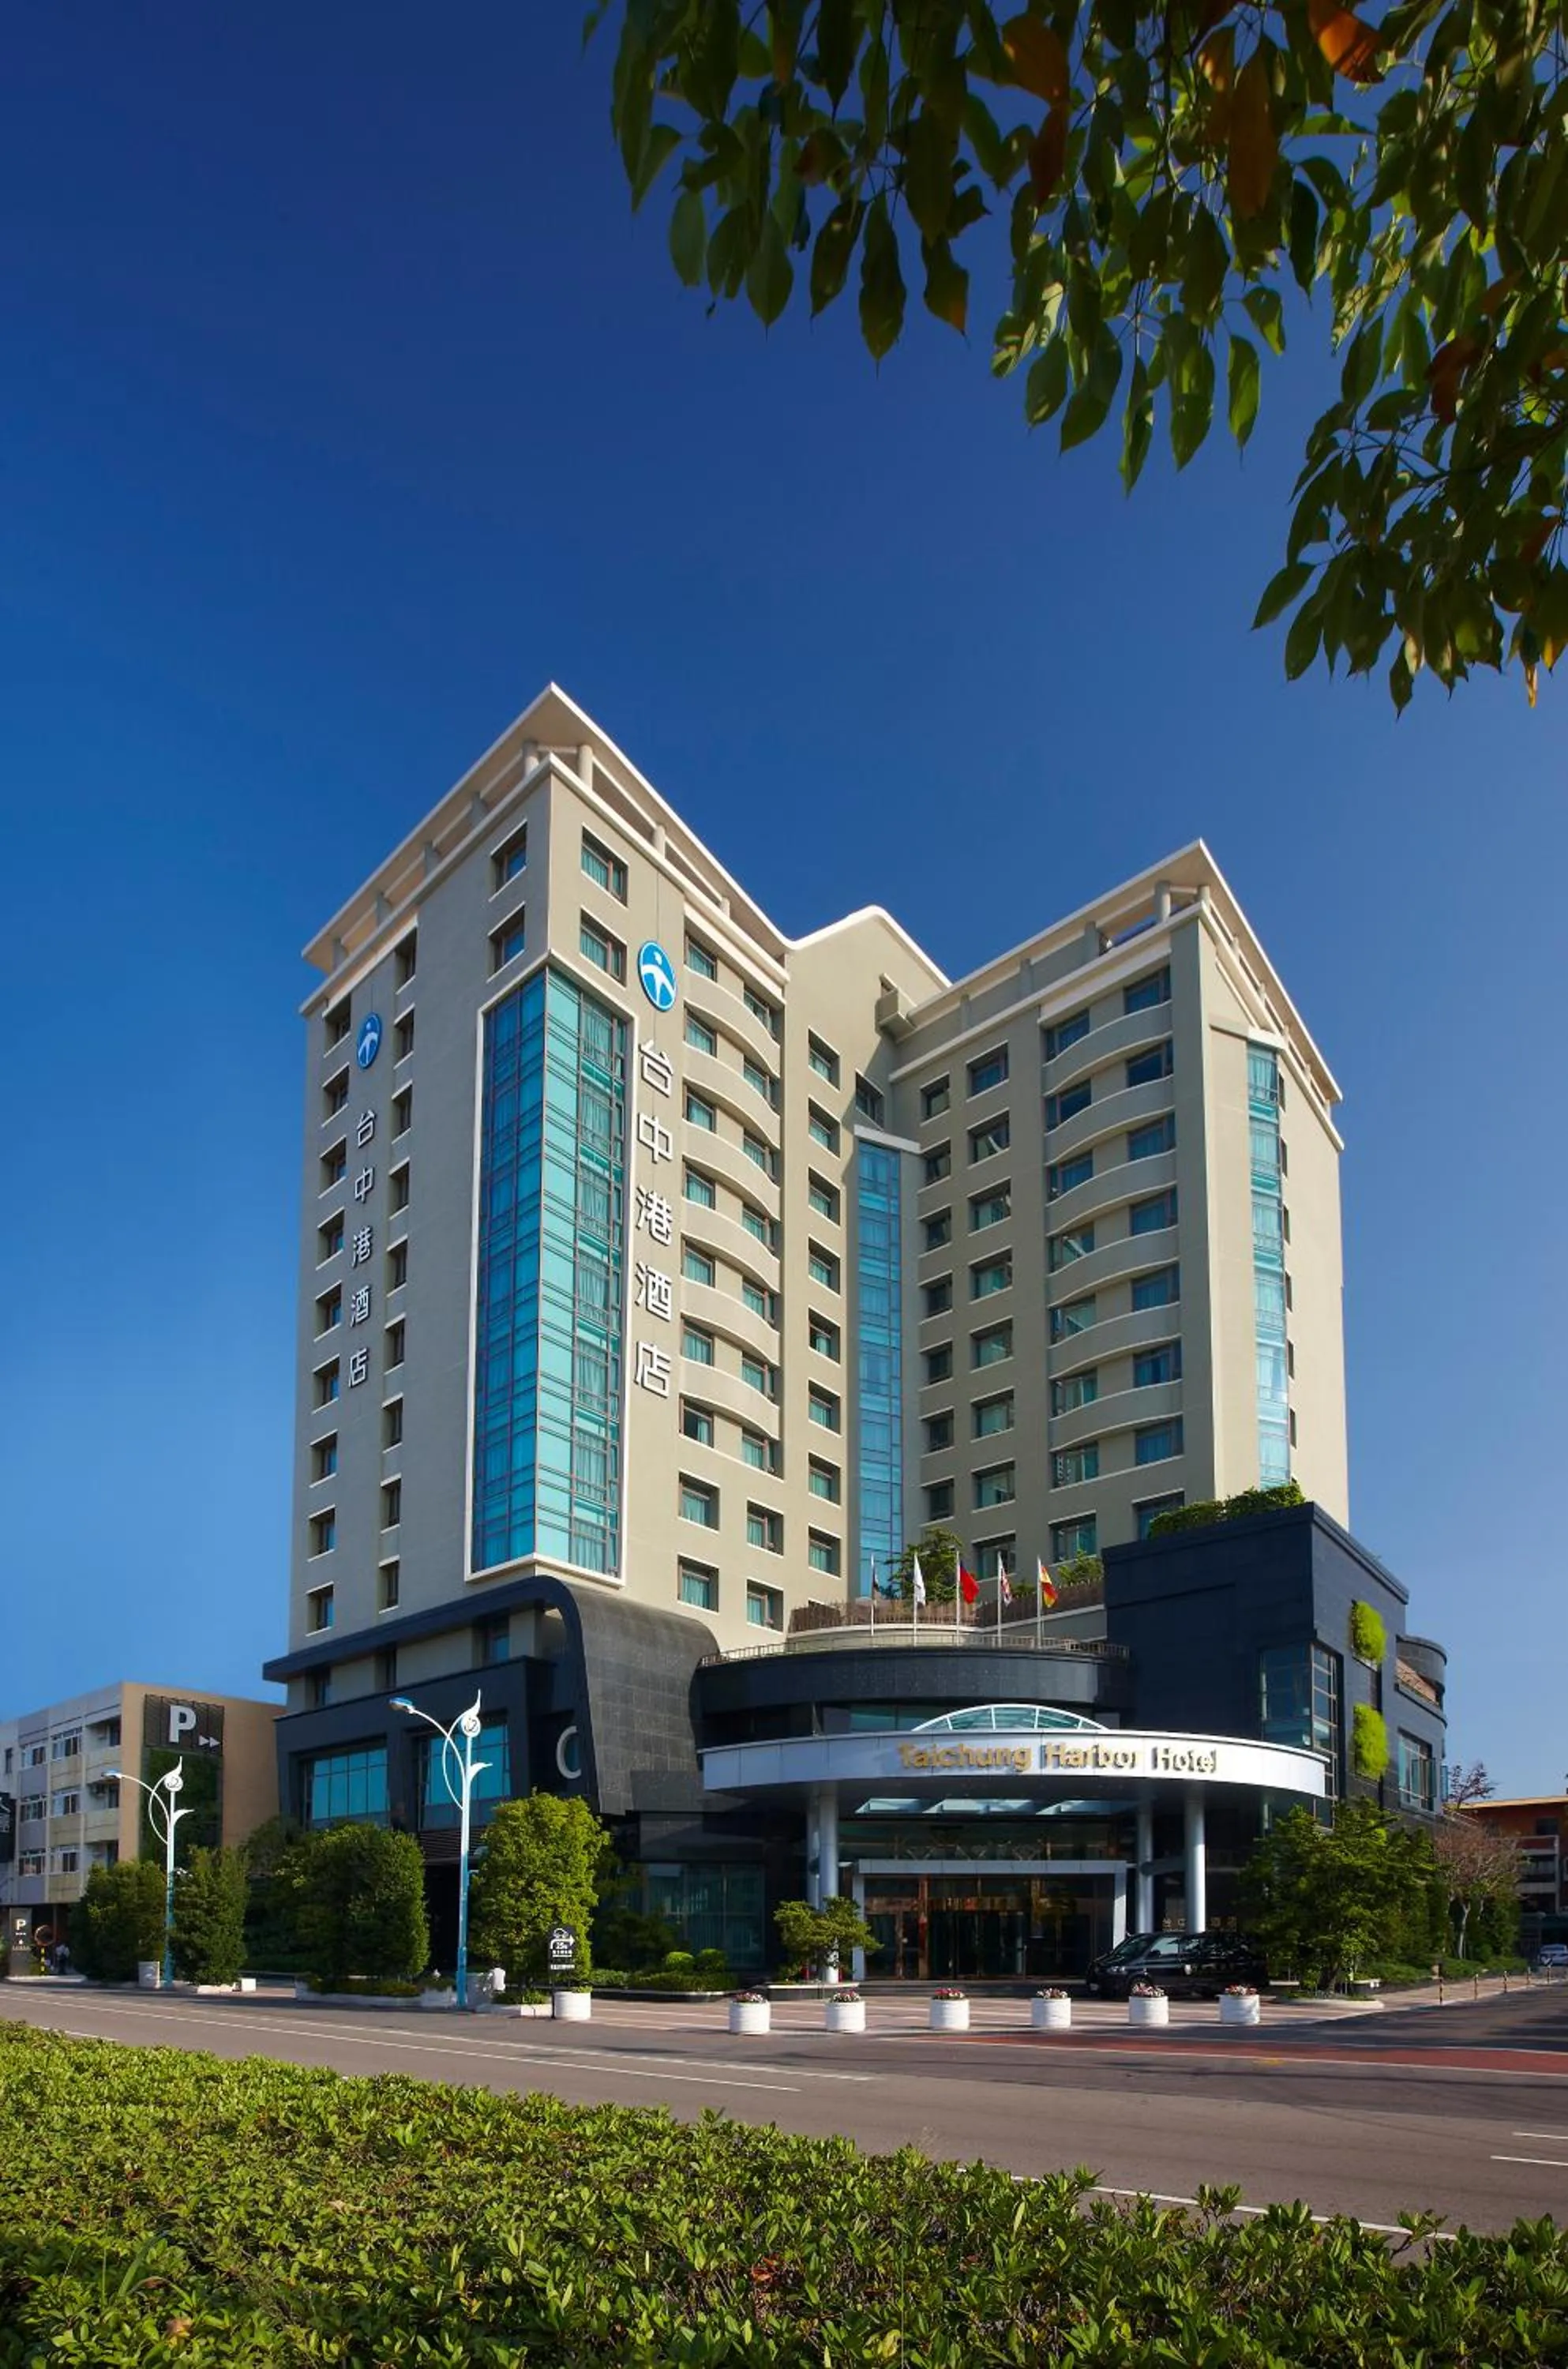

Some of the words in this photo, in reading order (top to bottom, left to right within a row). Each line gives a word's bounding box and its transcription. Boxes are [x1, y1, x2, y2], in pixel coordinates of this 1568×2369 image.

[634, 1038, 673, 1398] 台中港酒店
[348, 1109, 376, 1388] 台中港酒店
[168, 1705, 197, 1743] P
[898, 1743, 1032, 1772] Taichung
[1041, 1742, 1137, 1770] Harbor
[1150, 1745, 1217, 1774] Hotel
[17, 1919, 27, 1931] P
